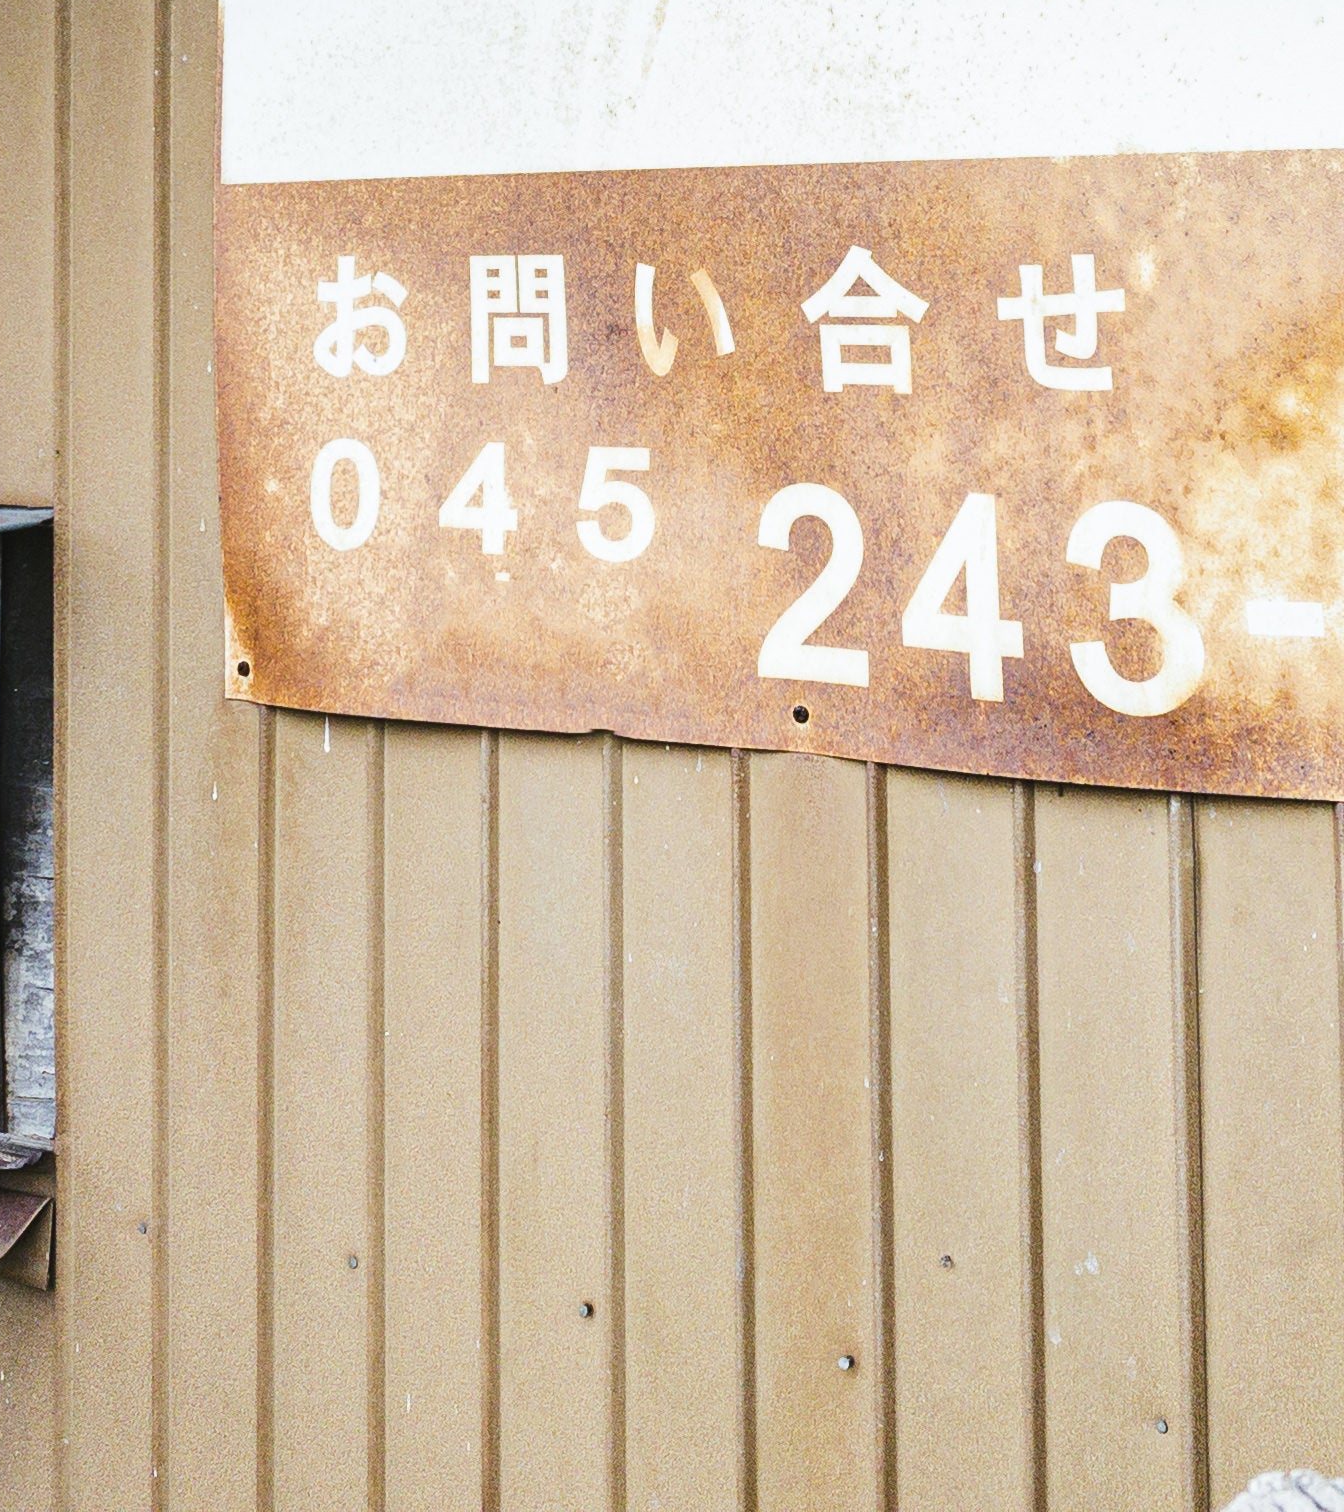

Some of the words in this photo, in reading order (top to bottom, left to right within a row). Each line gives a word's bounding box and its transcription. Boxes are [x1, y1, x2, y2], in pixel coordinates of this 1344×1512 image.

[313, 245, 1126, 394] お問い合せ
[310, 437, 656, 564] 045
